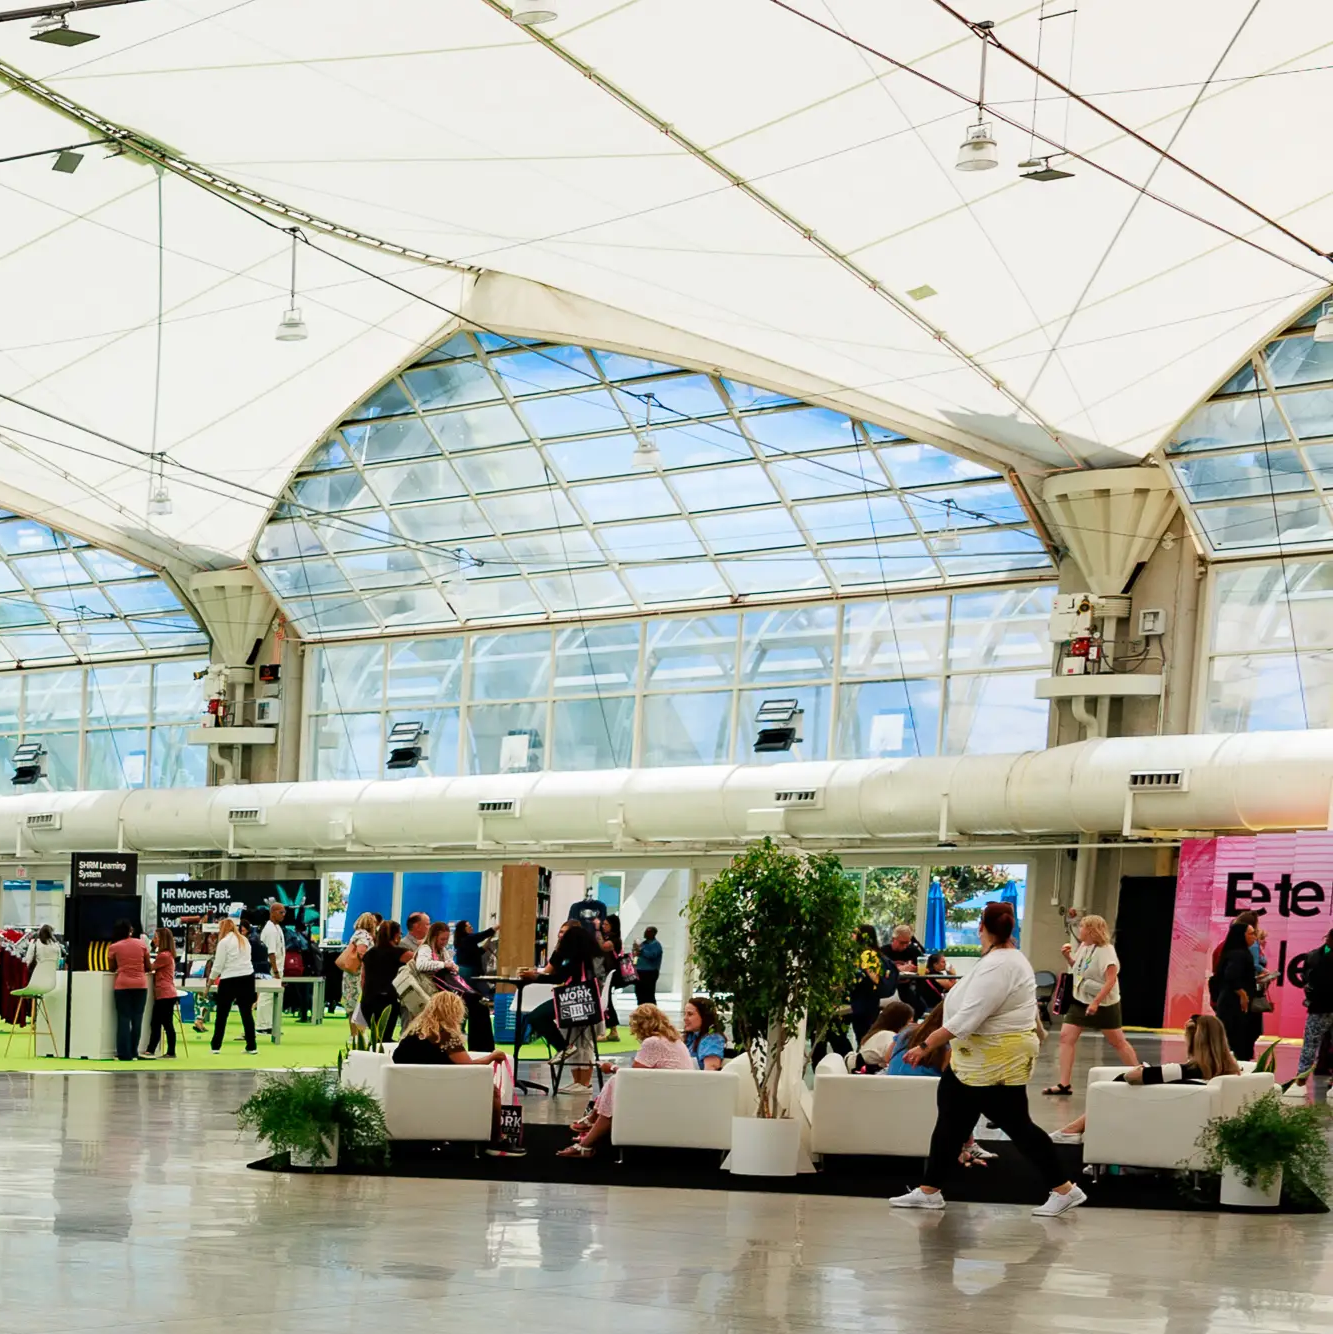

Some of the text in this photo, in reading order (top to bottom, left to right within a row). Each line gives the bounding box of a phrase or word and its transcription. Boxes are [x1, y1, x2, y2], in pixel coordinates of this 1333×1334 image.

[79, 861, 127, 872] SHRM Learning
[78, 870, 102, 879] System
[161, 888, 231, 899] HR Moves Fast.
[559, 988, 592, 1002] WORK
